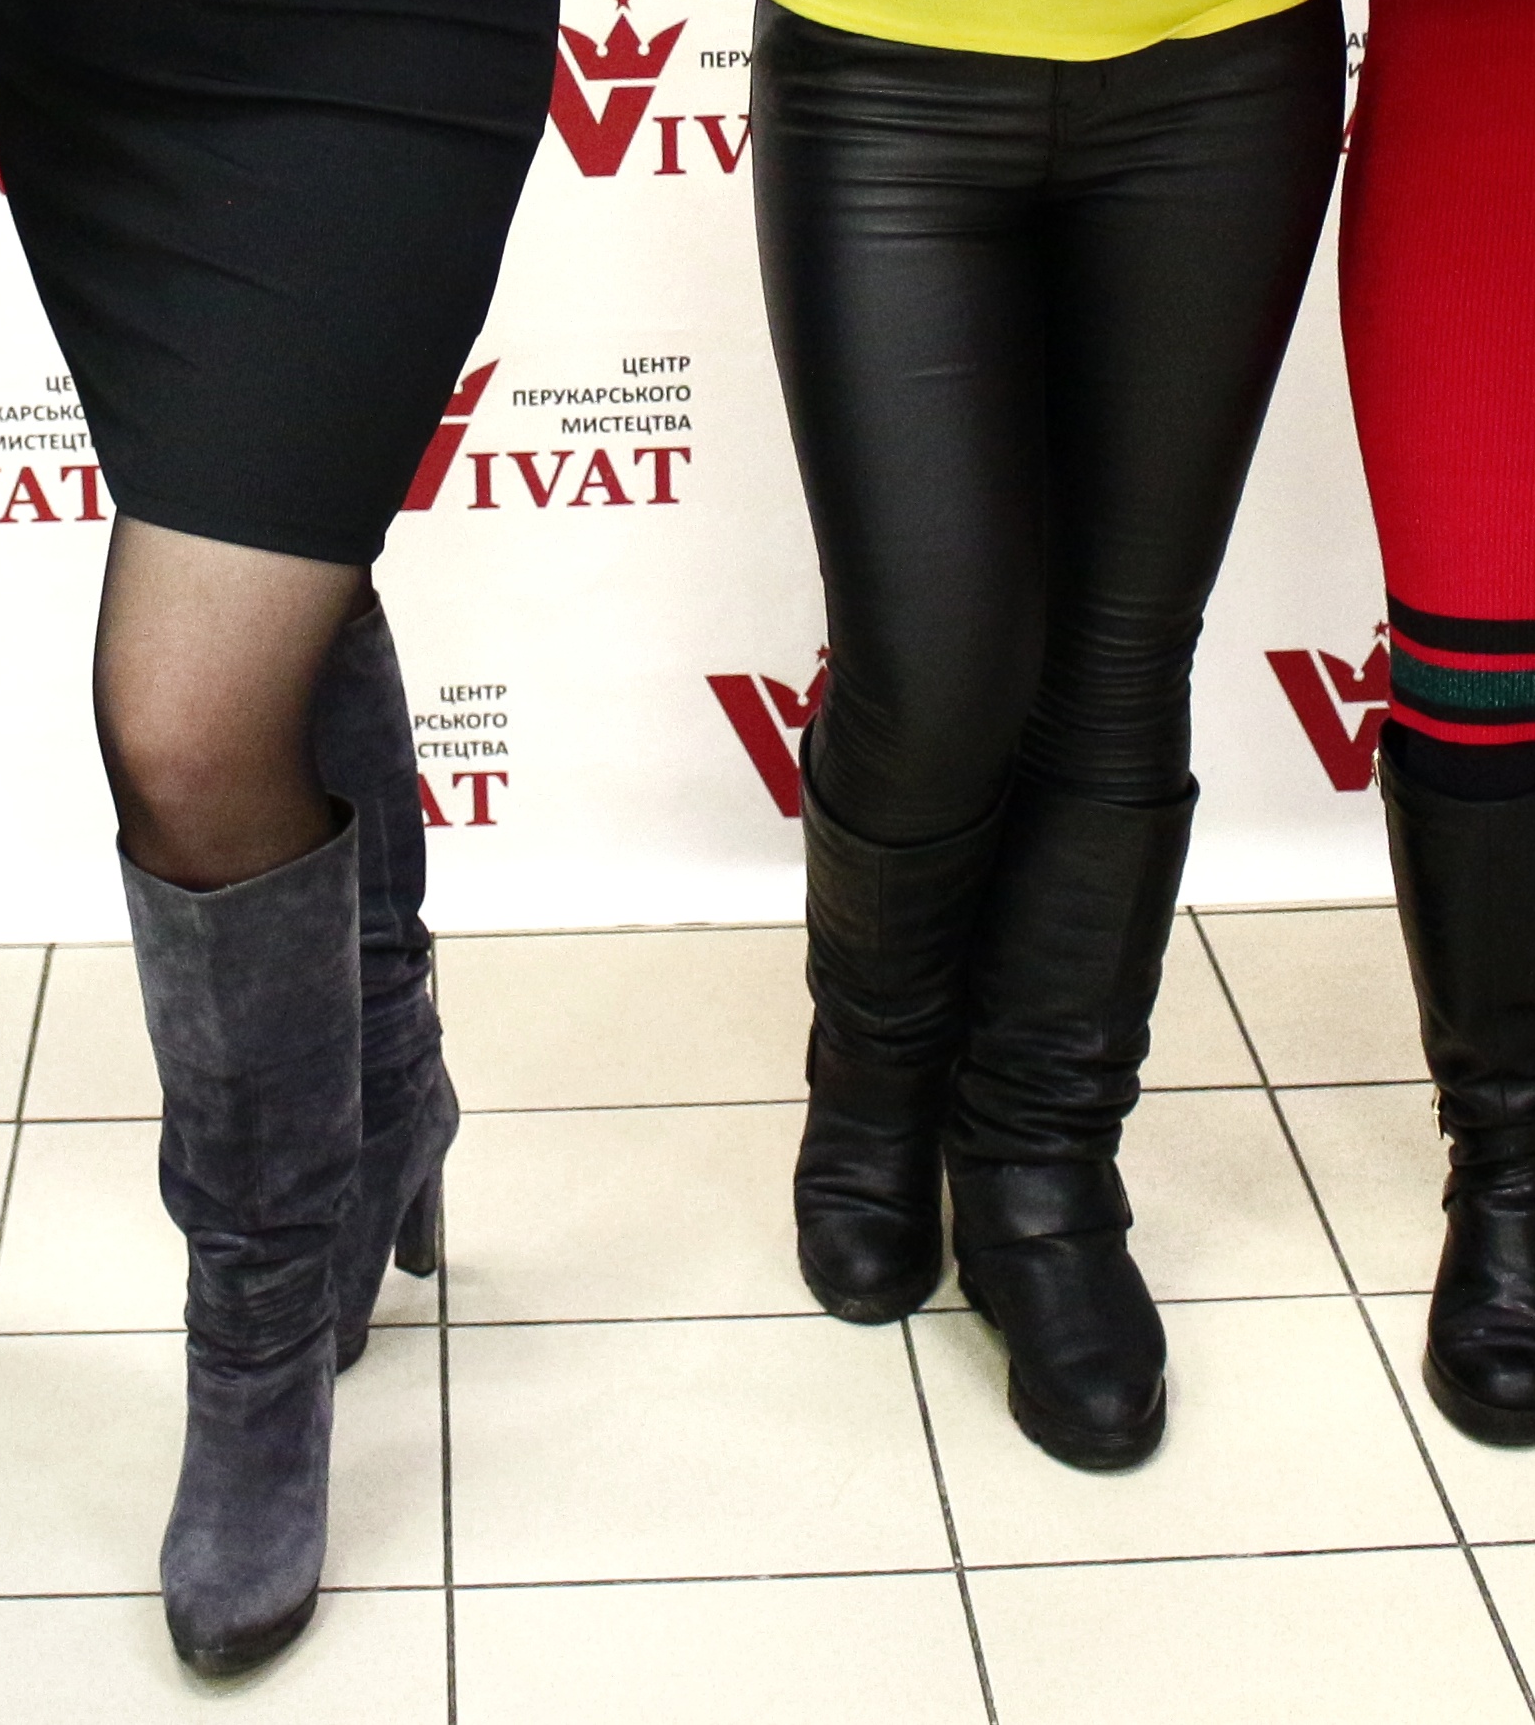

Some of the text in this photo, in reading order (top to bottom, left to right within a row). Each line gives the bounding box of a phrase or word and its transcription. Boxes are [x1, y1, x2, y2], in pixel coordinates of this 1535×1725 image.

[622, 355, 691, 378] ЦЕНТР
[512, 384, 692, 407] ПЕРУКАРСЬКОГО
[561, 413, 692, 435] МИСТЕЦТВА
[439, 684, 508, 705] ЦЕНТР
[413, 714, 509, 735] РСЬКОГО
[417, 741, 509, 763] СТЕЦТВА
